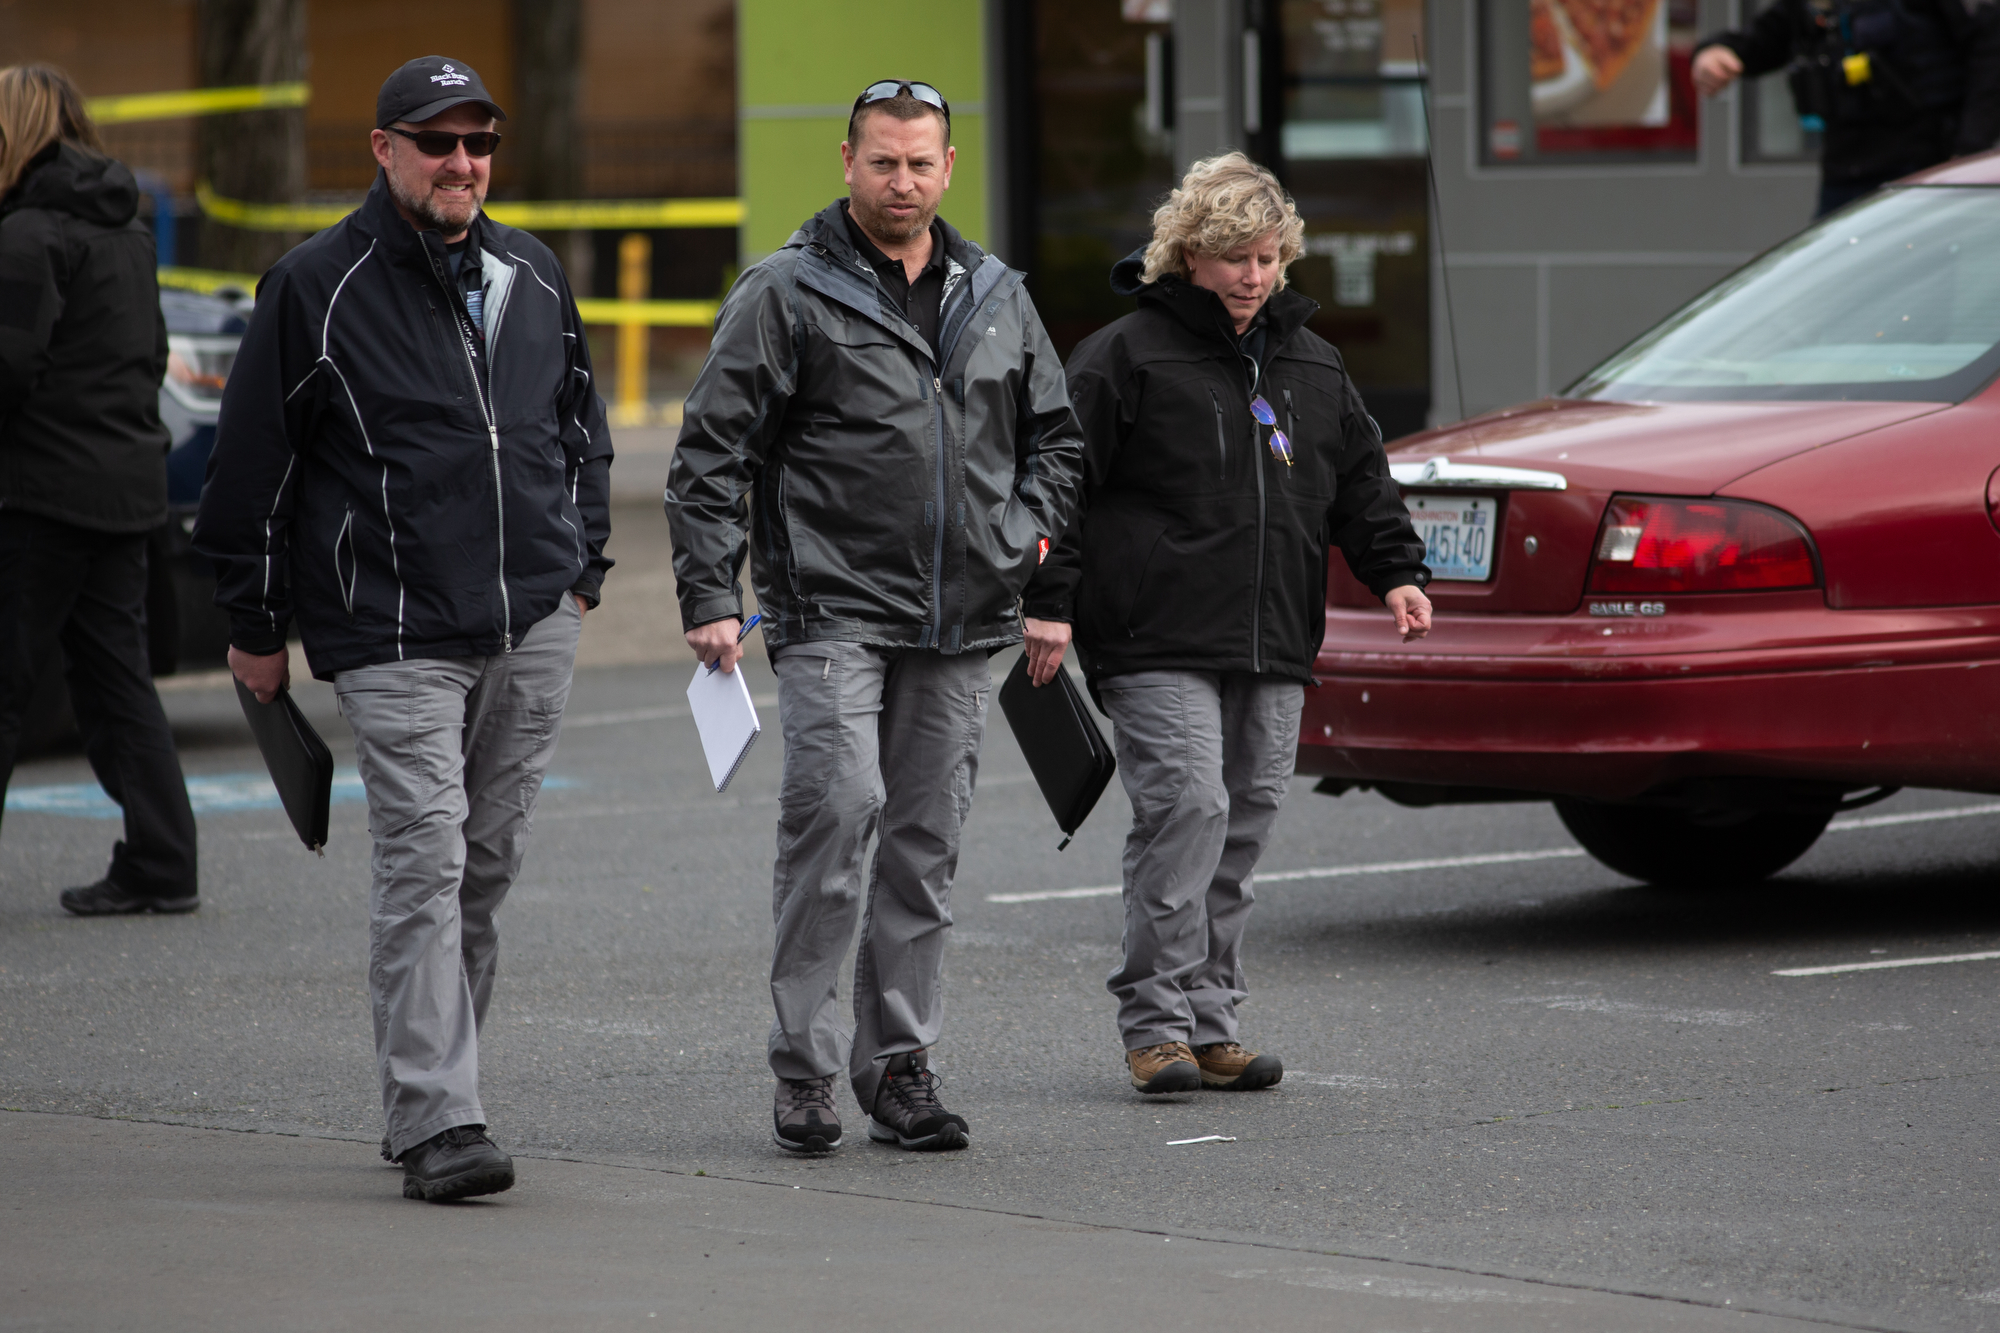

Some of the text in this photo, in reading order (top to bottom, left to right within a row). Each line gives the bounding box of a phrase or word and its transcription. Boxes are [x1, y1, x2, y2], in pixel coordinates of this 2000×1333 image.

[430, 73, 451, 82] Black
[1411, 511, 1458, 521] WASHINGTON
[1589, 601, 1666, 616] SABLE GS
